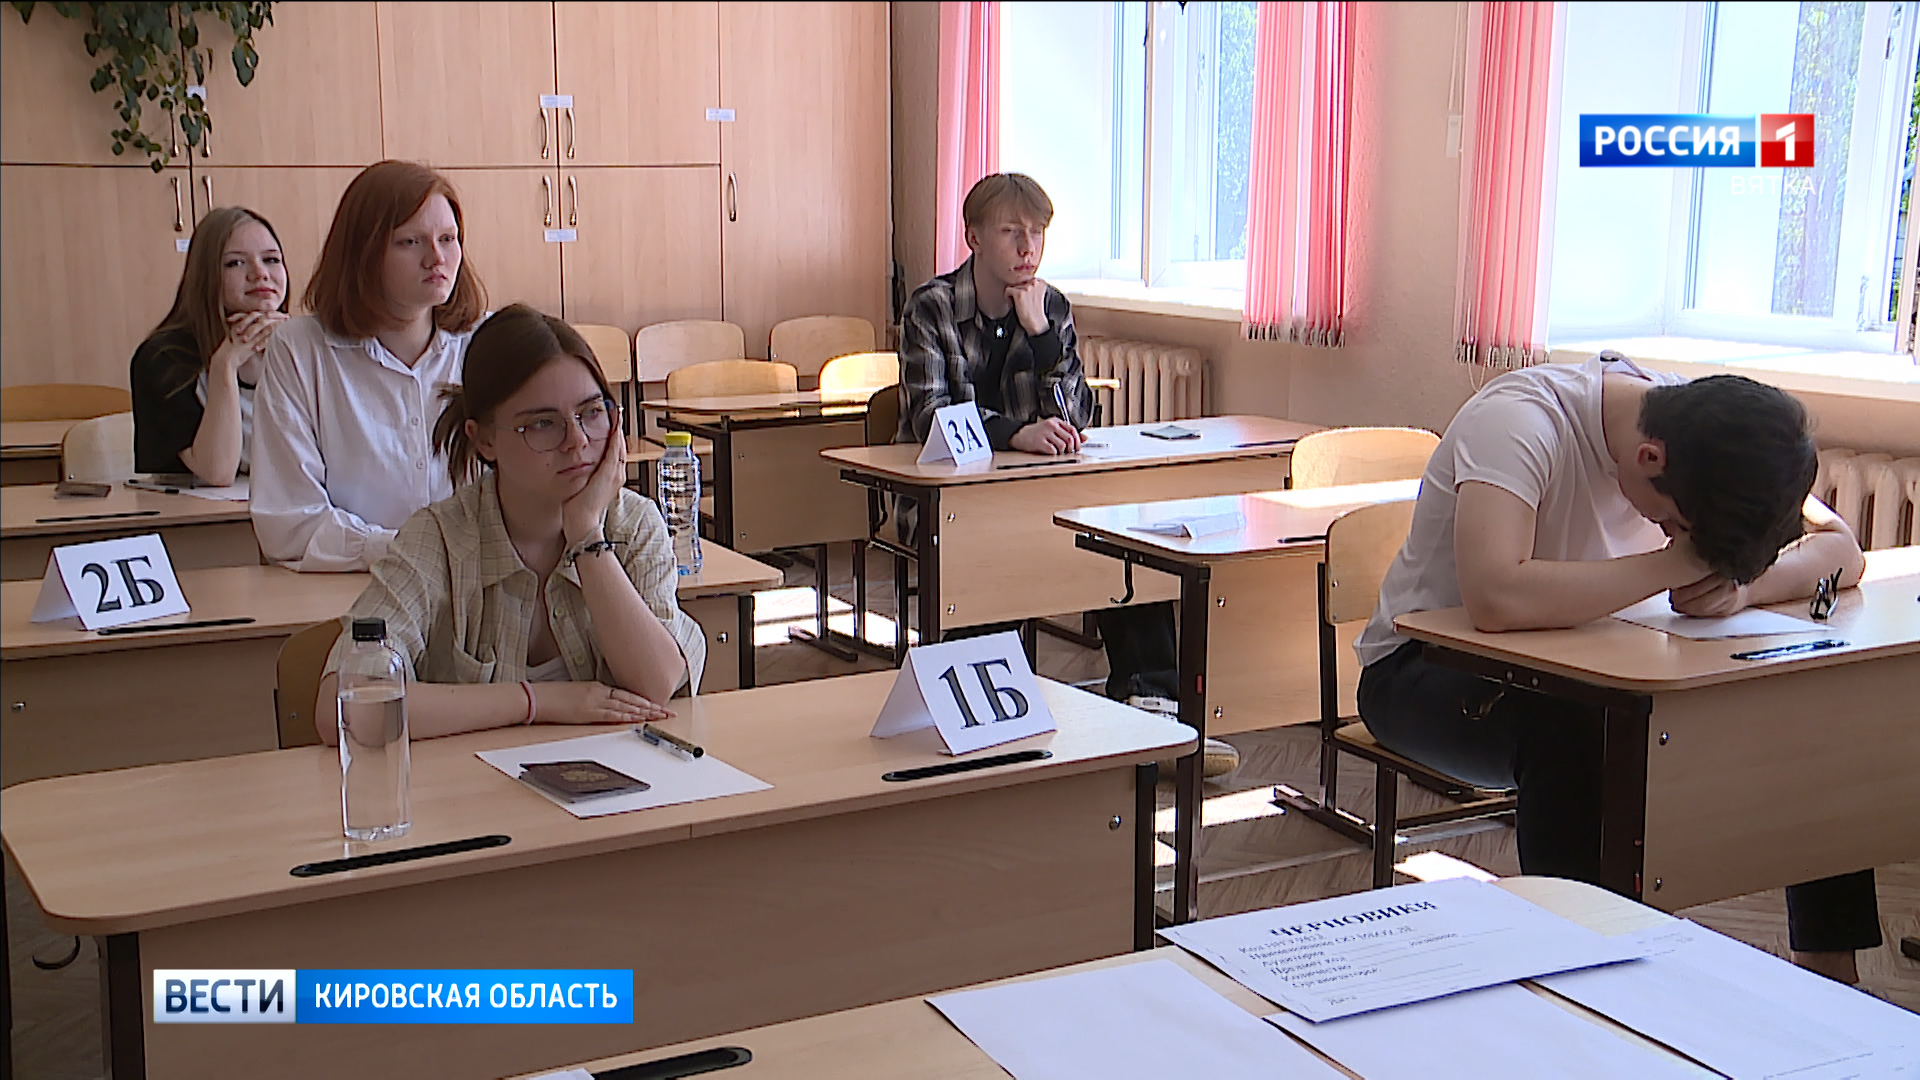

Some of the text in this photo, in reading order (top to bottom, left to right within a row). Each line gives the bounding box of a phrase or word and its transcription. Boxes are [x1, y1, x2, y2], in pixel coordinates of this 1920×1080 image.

[947, 416, 984, 454] 3А
[81, 555, 165, 614] 2Б
[938, 657, 1029, 729] 1Б
[1268, 900, 1440, 936] ЧЕРНОВИКИ
